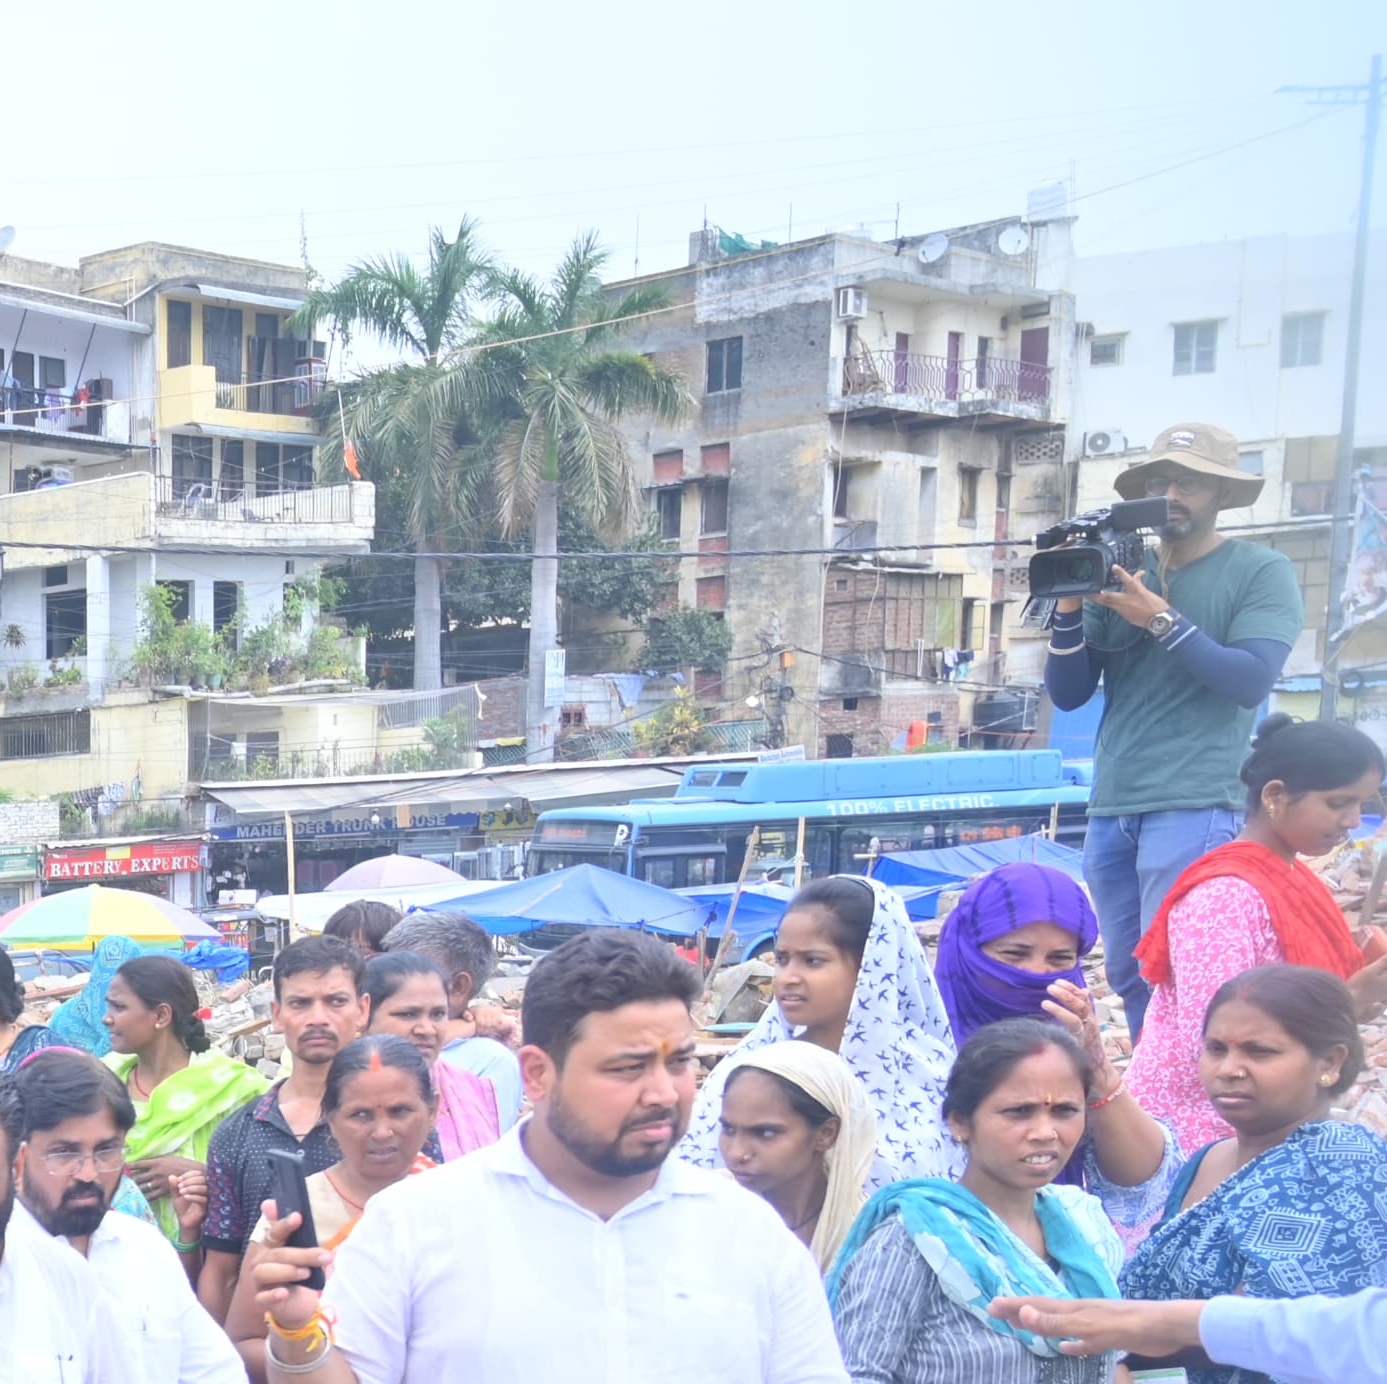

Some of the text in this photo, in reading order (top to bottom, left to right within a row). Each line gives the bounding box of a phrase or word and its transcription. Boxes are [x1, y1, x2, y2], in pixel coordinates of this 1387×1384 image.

[827, 800, 887, 816] 100%
[50, 855, 199, 877] BATTERY EXPERTS
